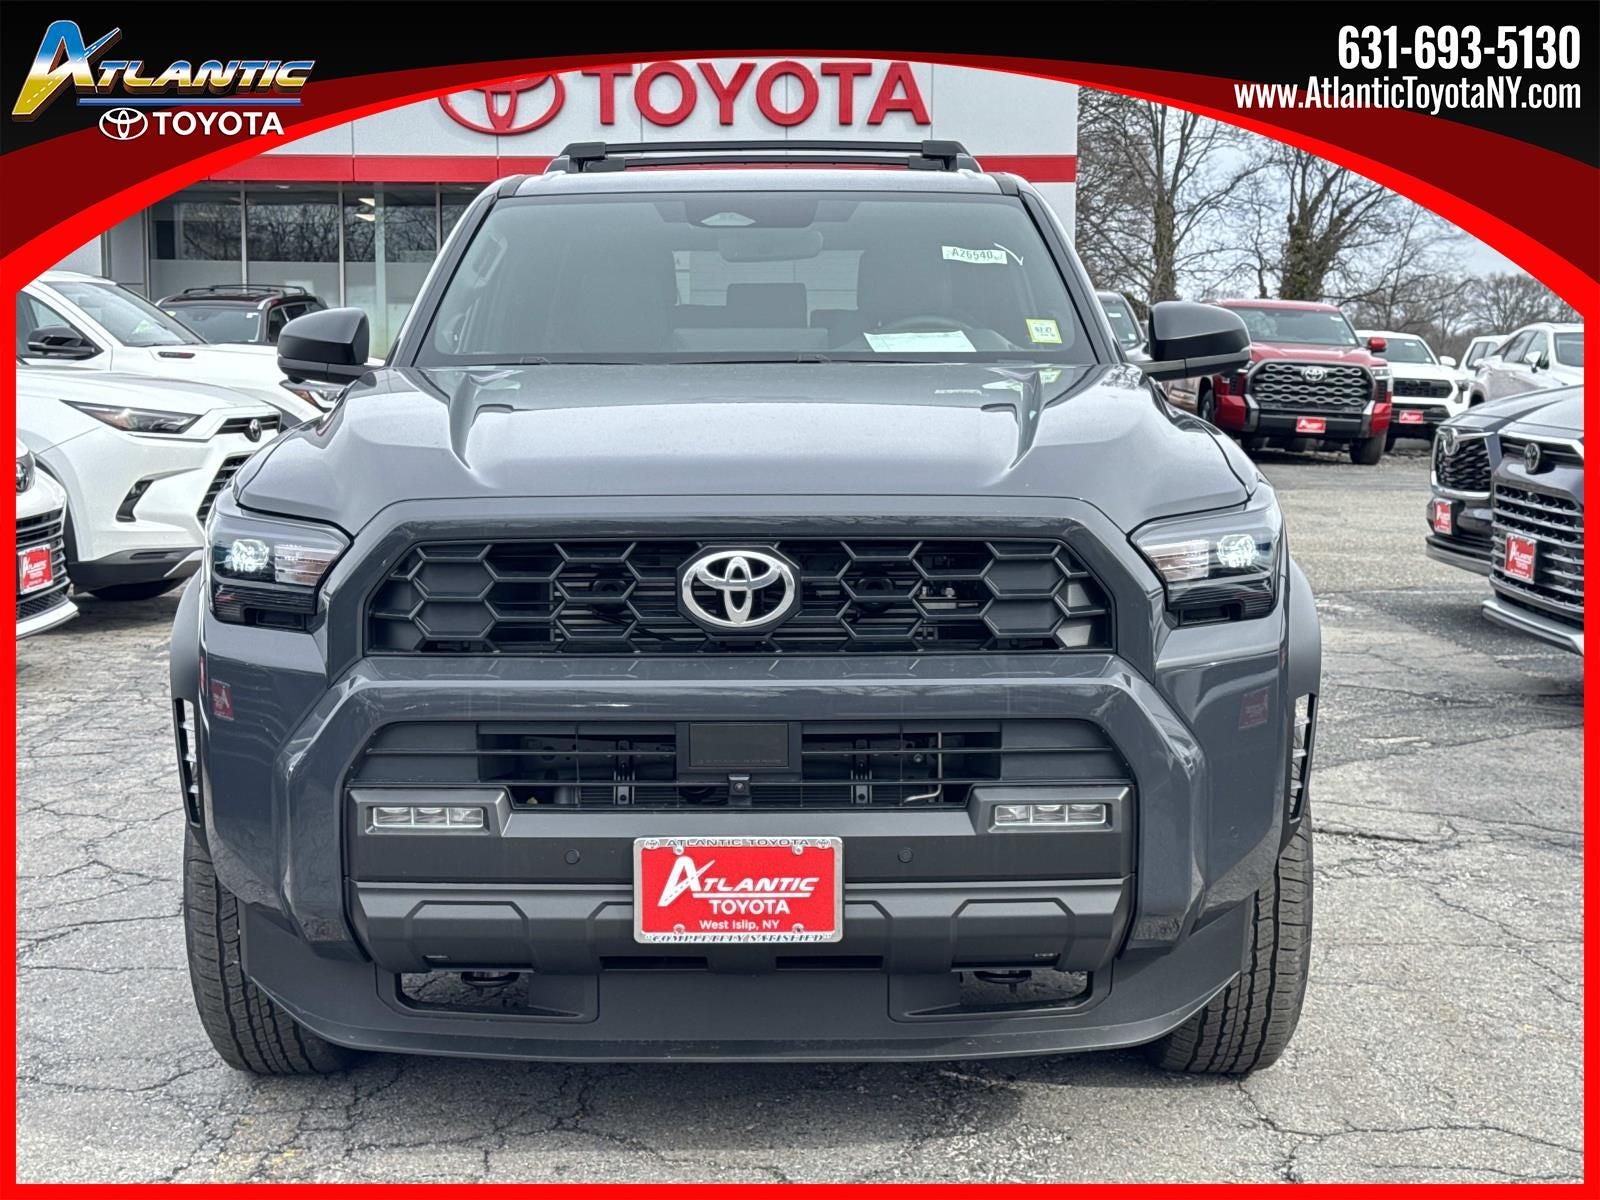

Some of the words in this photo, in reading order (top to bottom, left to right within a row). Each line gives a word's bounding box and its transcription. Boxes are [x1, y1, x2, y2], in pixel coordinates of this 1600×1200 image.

[582, 60, 932, 127] TOYOTA
[657, 856, 819, 907] ATLANTIC
[709, 900, 790, 915] TOYOTA
[699, 919, 729, 930] West
[732, 919, 759, 931] Islip,
[762, 919, 780, 930] NY
